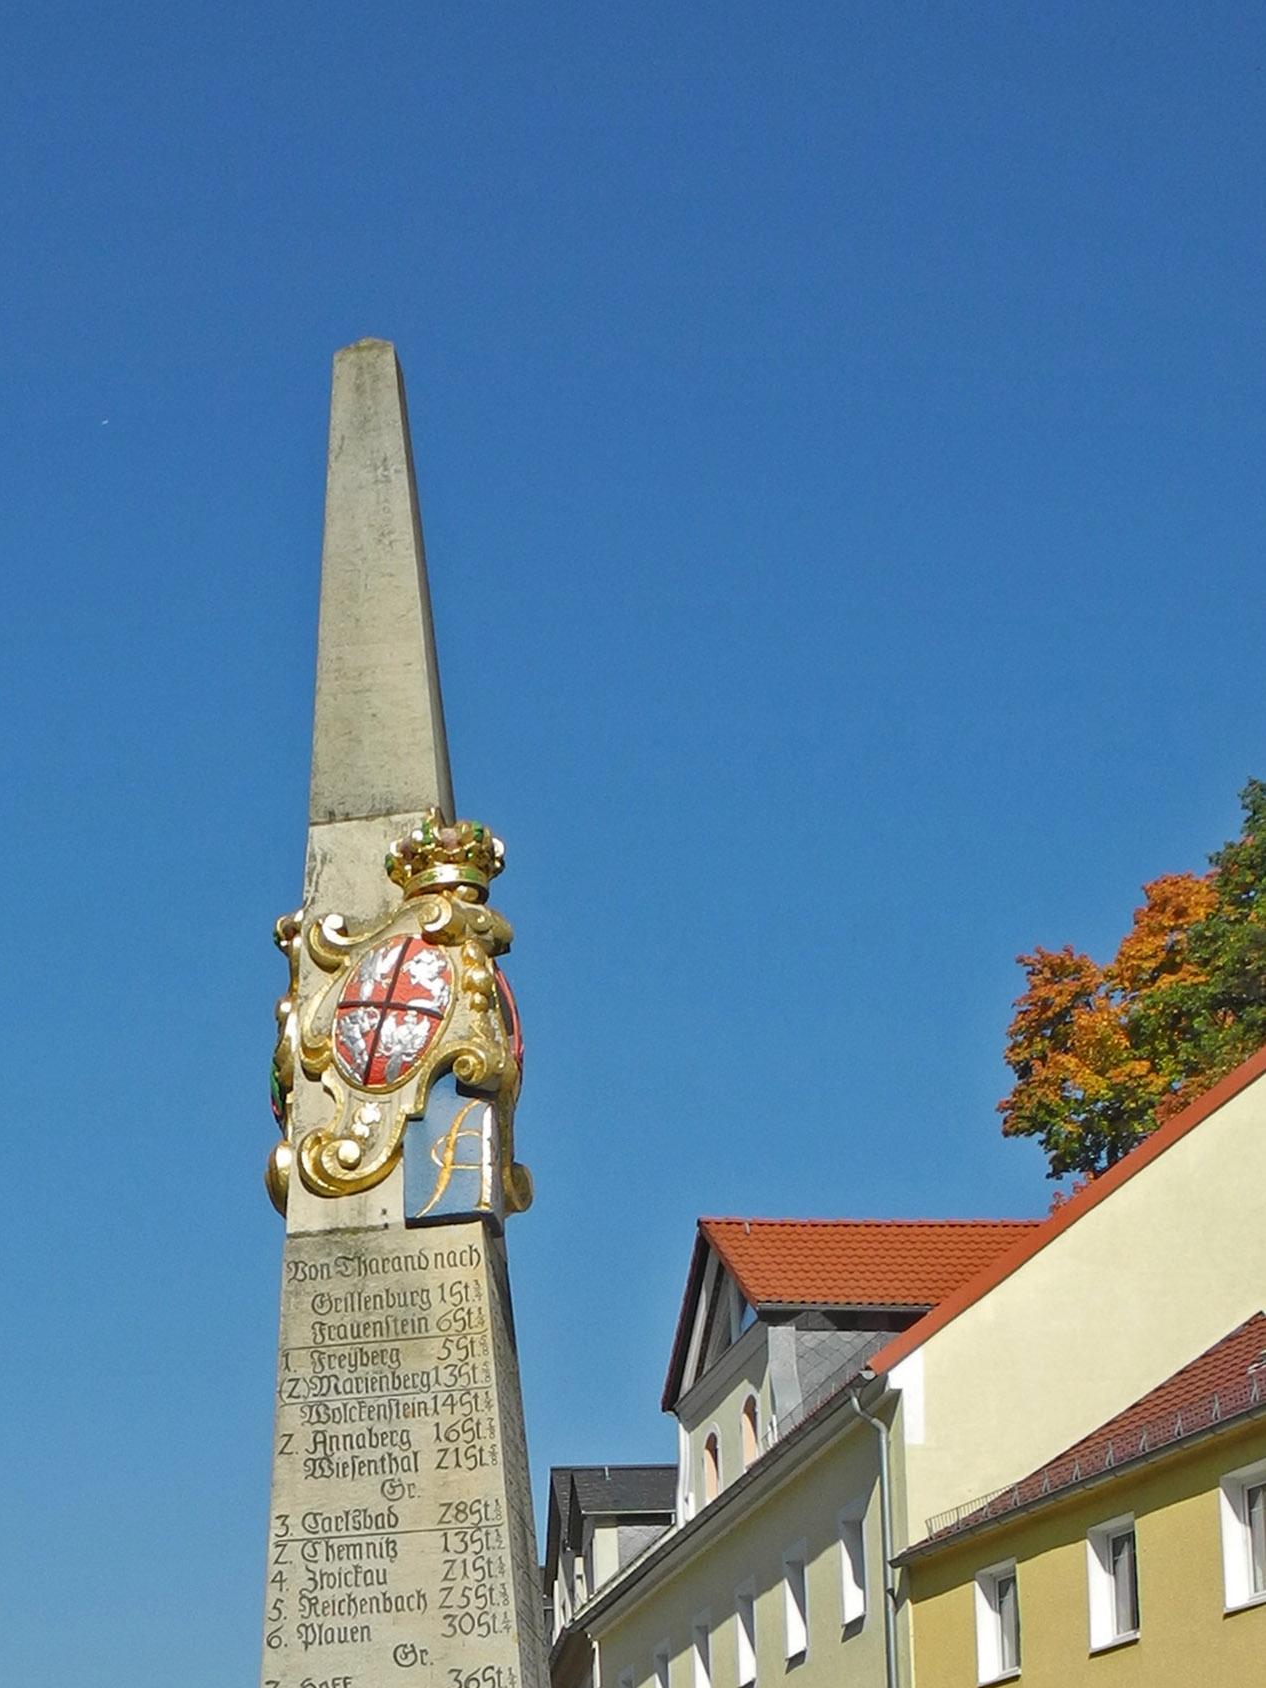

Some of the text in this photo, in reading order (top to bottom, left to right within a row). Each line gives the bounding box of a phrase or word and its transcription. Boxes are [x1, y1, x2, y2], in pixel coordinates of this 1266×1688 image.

[287, 1260, 332, 1283] Von
[434, 1244, 481, 1270] nach
[311, 1287, 432, 1316] Grillenburg
[306, 1426, 412, 1457] Annaberg
[297, 1622, 372, 1652] Plauen
